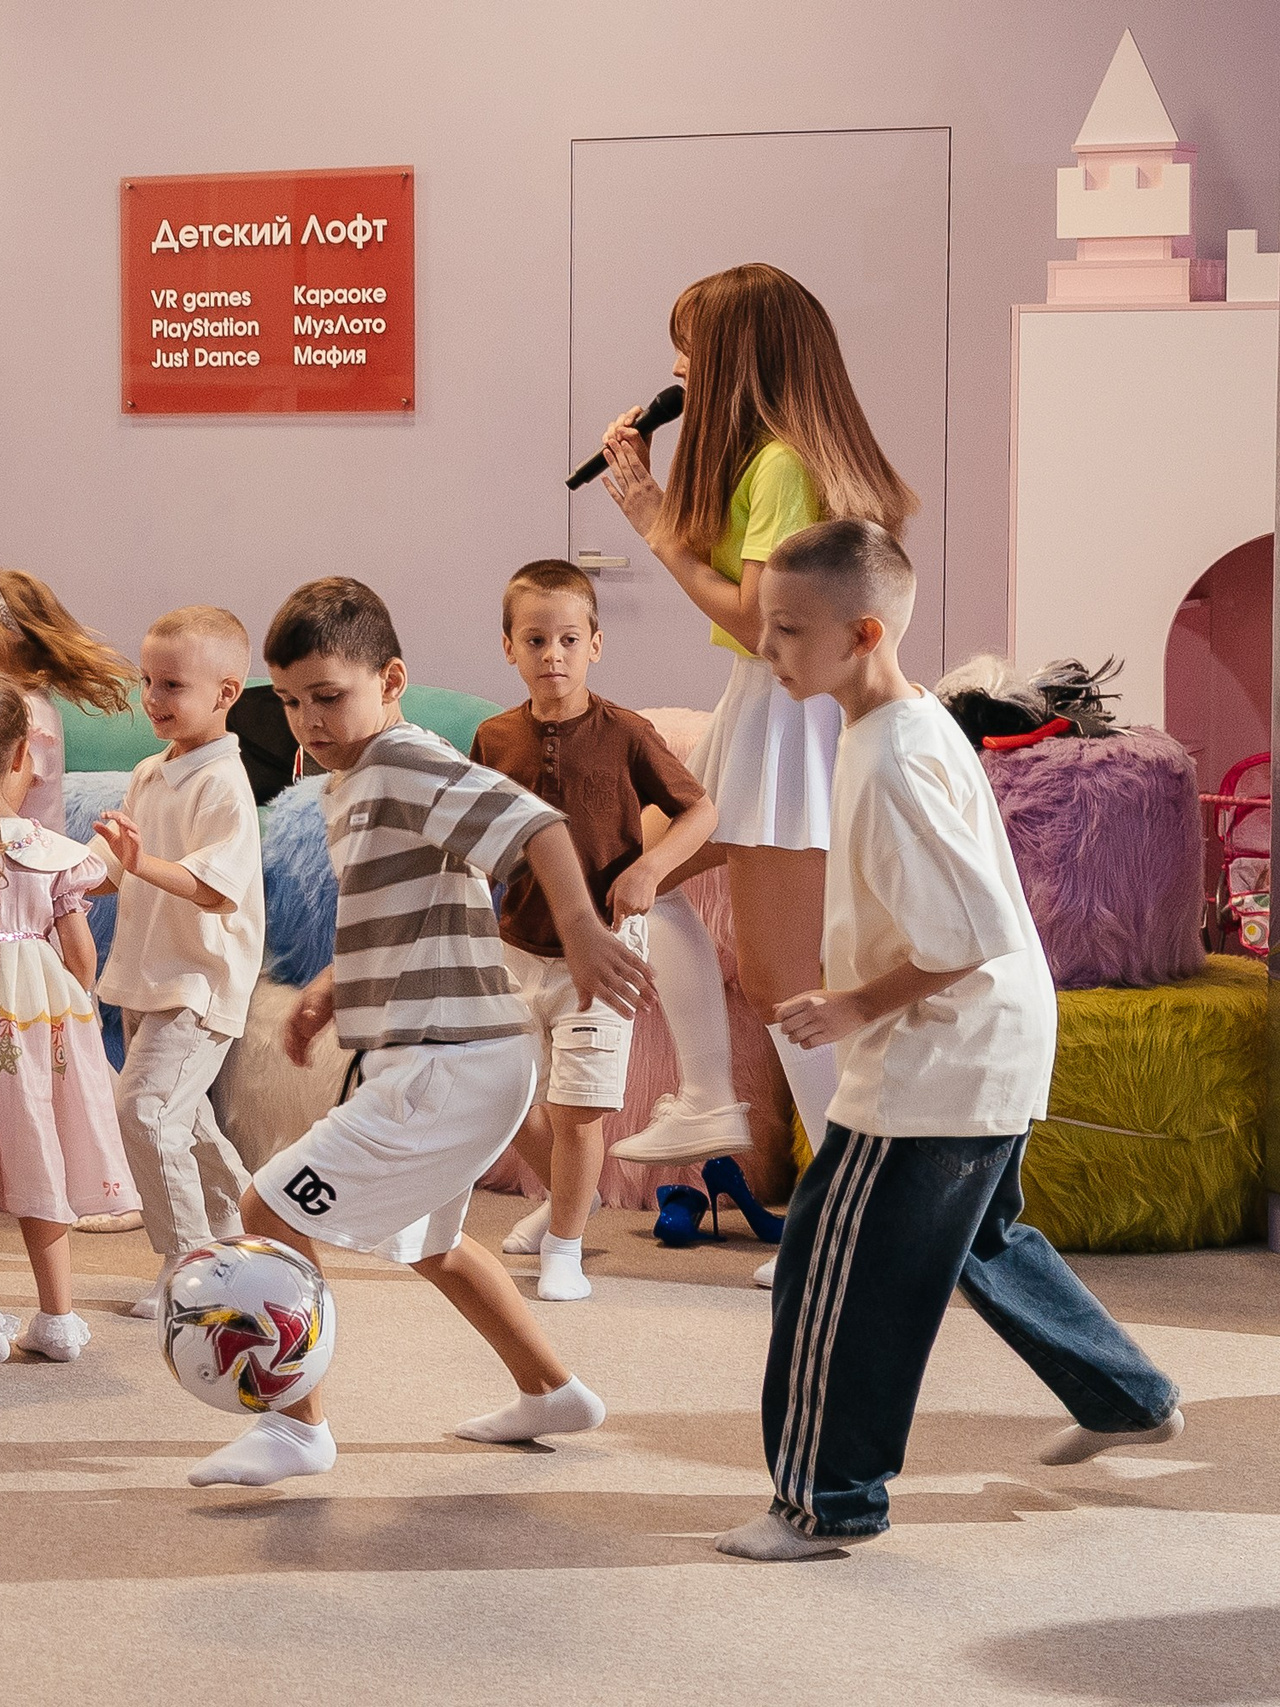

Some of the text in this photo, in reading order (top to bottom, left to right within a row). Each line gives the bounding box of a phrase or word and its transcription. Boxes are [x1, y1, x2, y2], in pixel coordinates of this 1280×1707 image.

[151, 213, 388, 254] Детский Лофт
[151, 289, 252, 313] VR games
[293, 285, 387, 308] Караоке
[151, 317, 260, 341] PlayStation
[293, 314, 387, 338] МузЛото
[151, 347, 261, 368] Just Dance
[293, 345, 367, 368] Мафия
